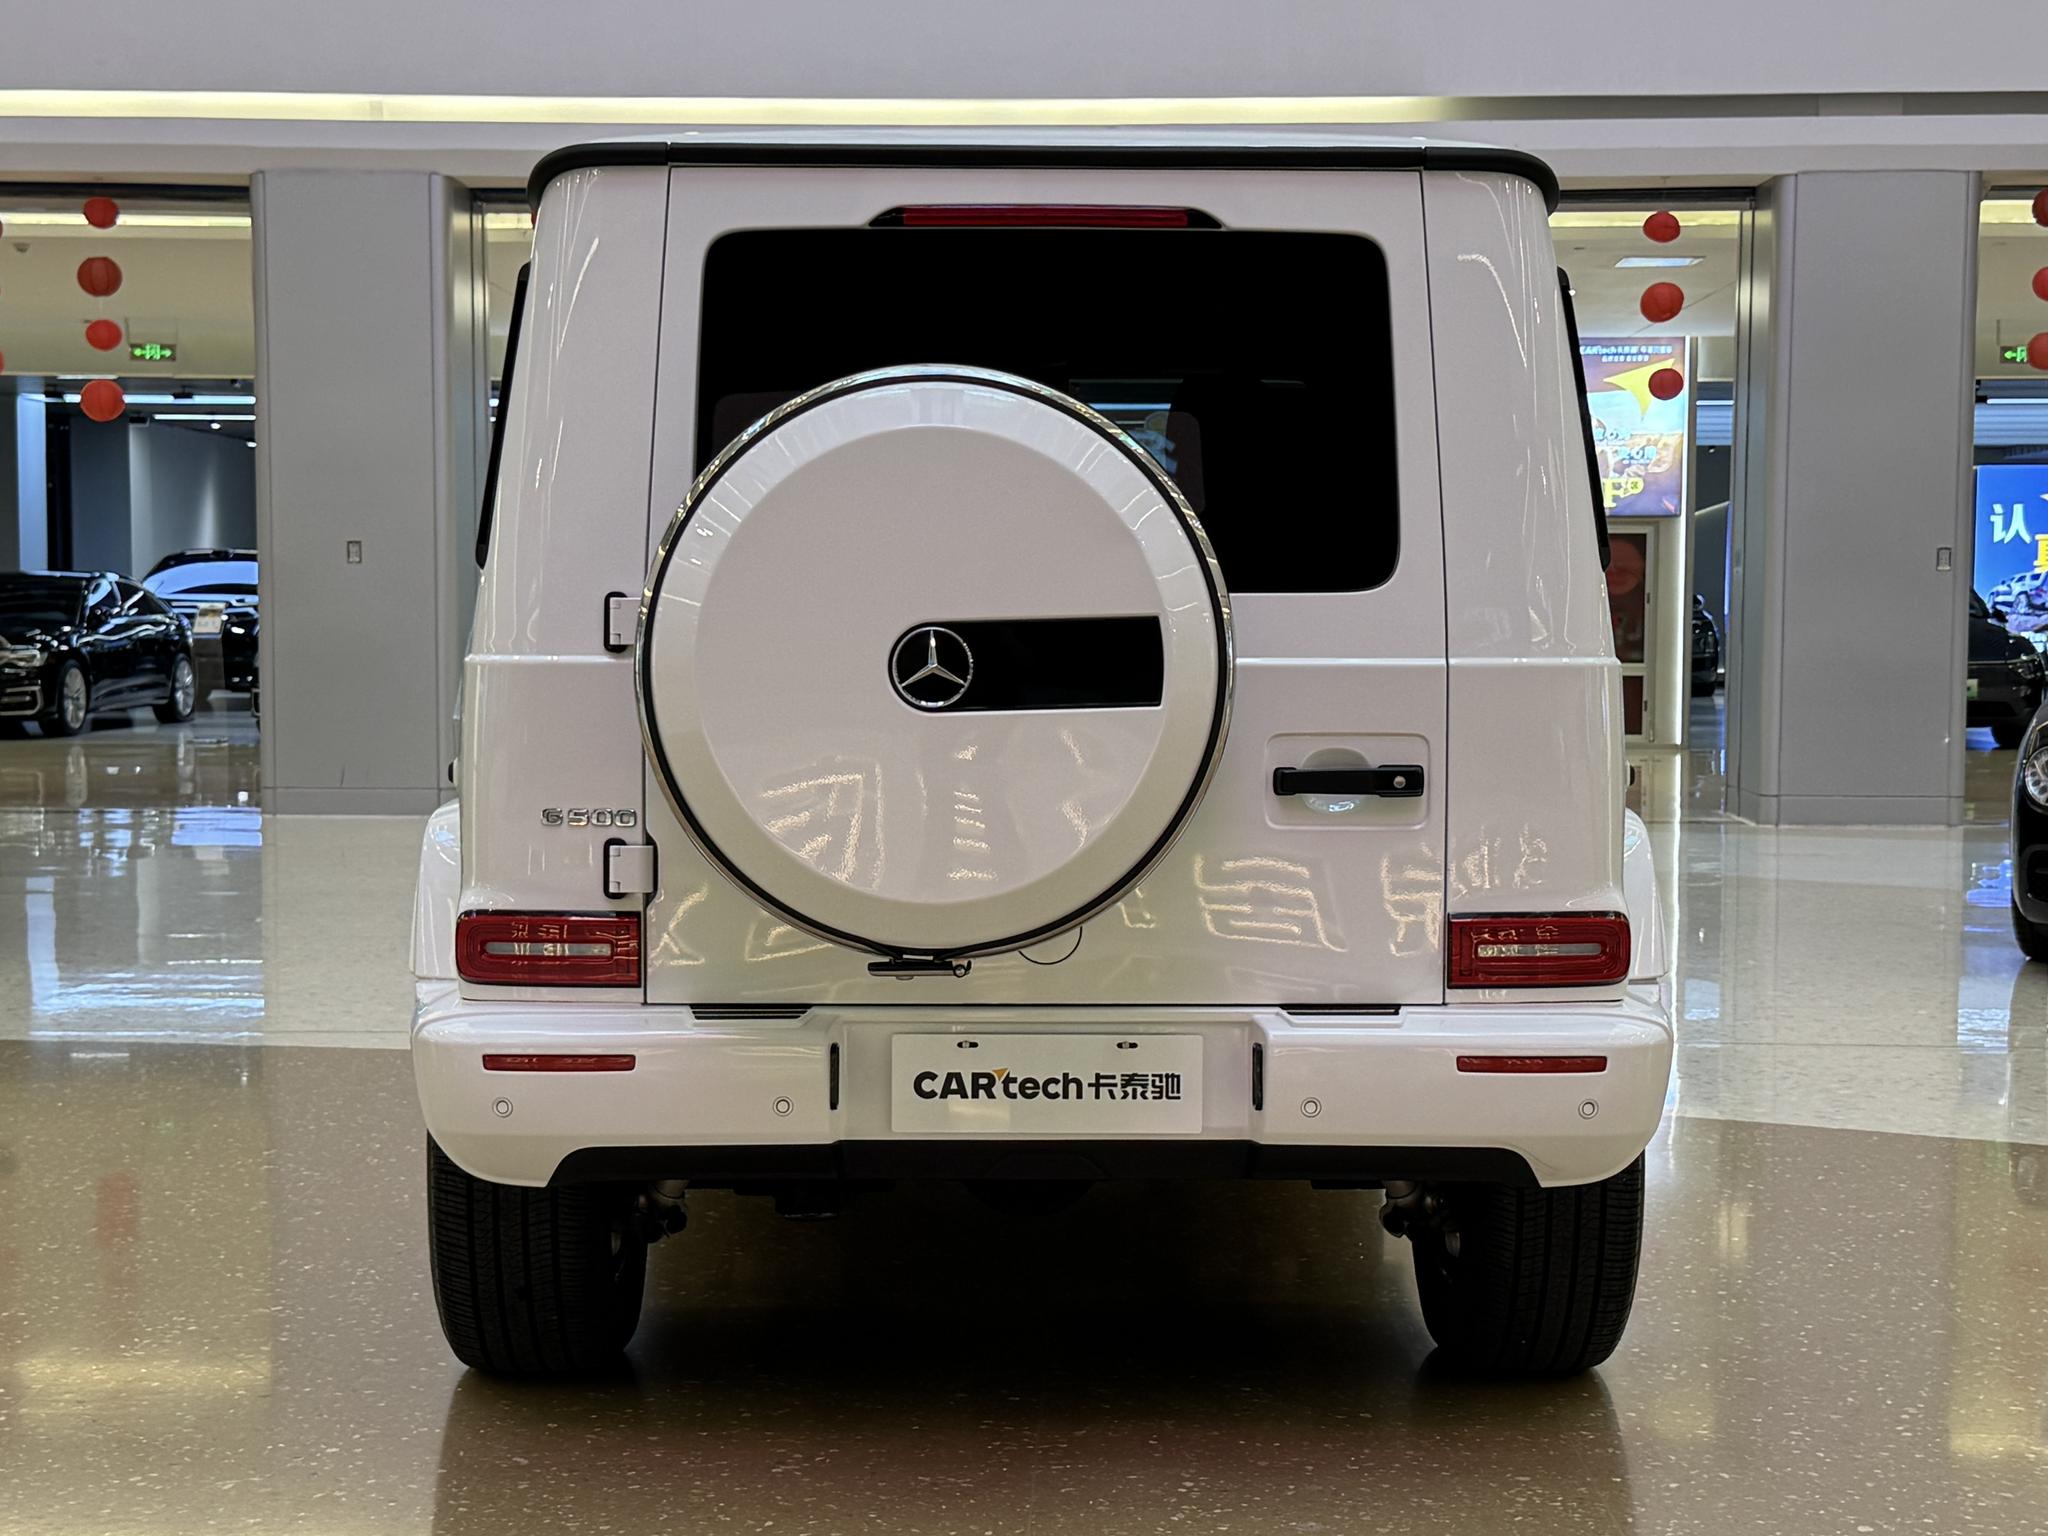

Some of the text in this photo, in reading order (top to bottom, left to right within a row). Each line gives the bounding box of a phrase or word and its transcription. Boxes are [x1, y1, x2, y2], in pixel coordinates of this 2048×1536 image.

[1990, 503, 2032, 544] 认
[913, 1068, 1182, 1100] CARtech 卡泰驰
